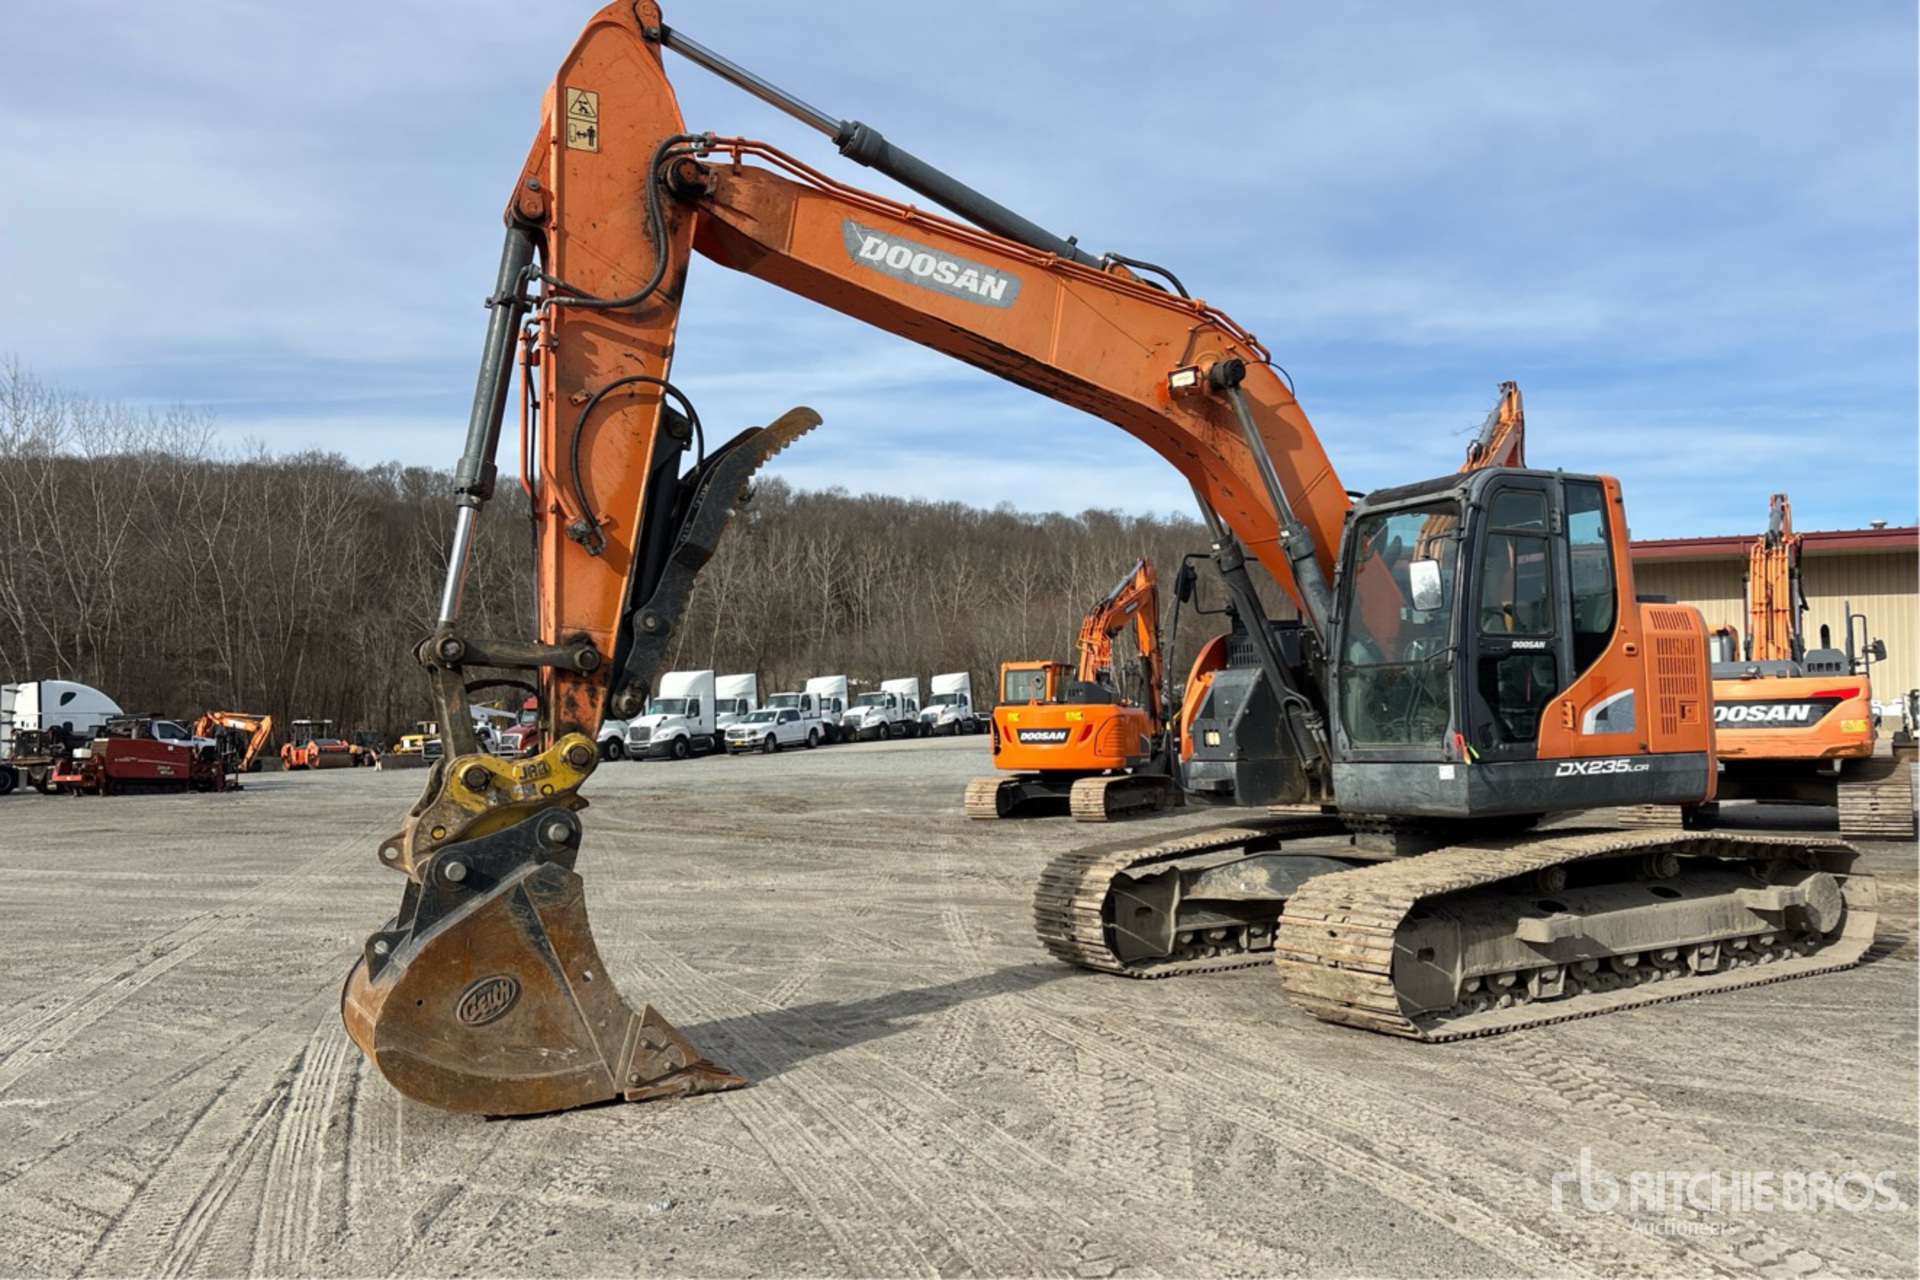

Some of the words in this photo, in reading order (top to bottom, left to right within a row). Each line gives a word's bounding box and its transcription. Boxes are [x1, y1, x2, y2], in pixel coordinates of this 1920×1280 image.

[859, 235, 1008, 300] DOOSAN
[1511, 641, 1546, 649] DOOSAN
[1714, 704, 1811, 722] OOSAN
[1020, 731, 1066, 741] DOOSAN
